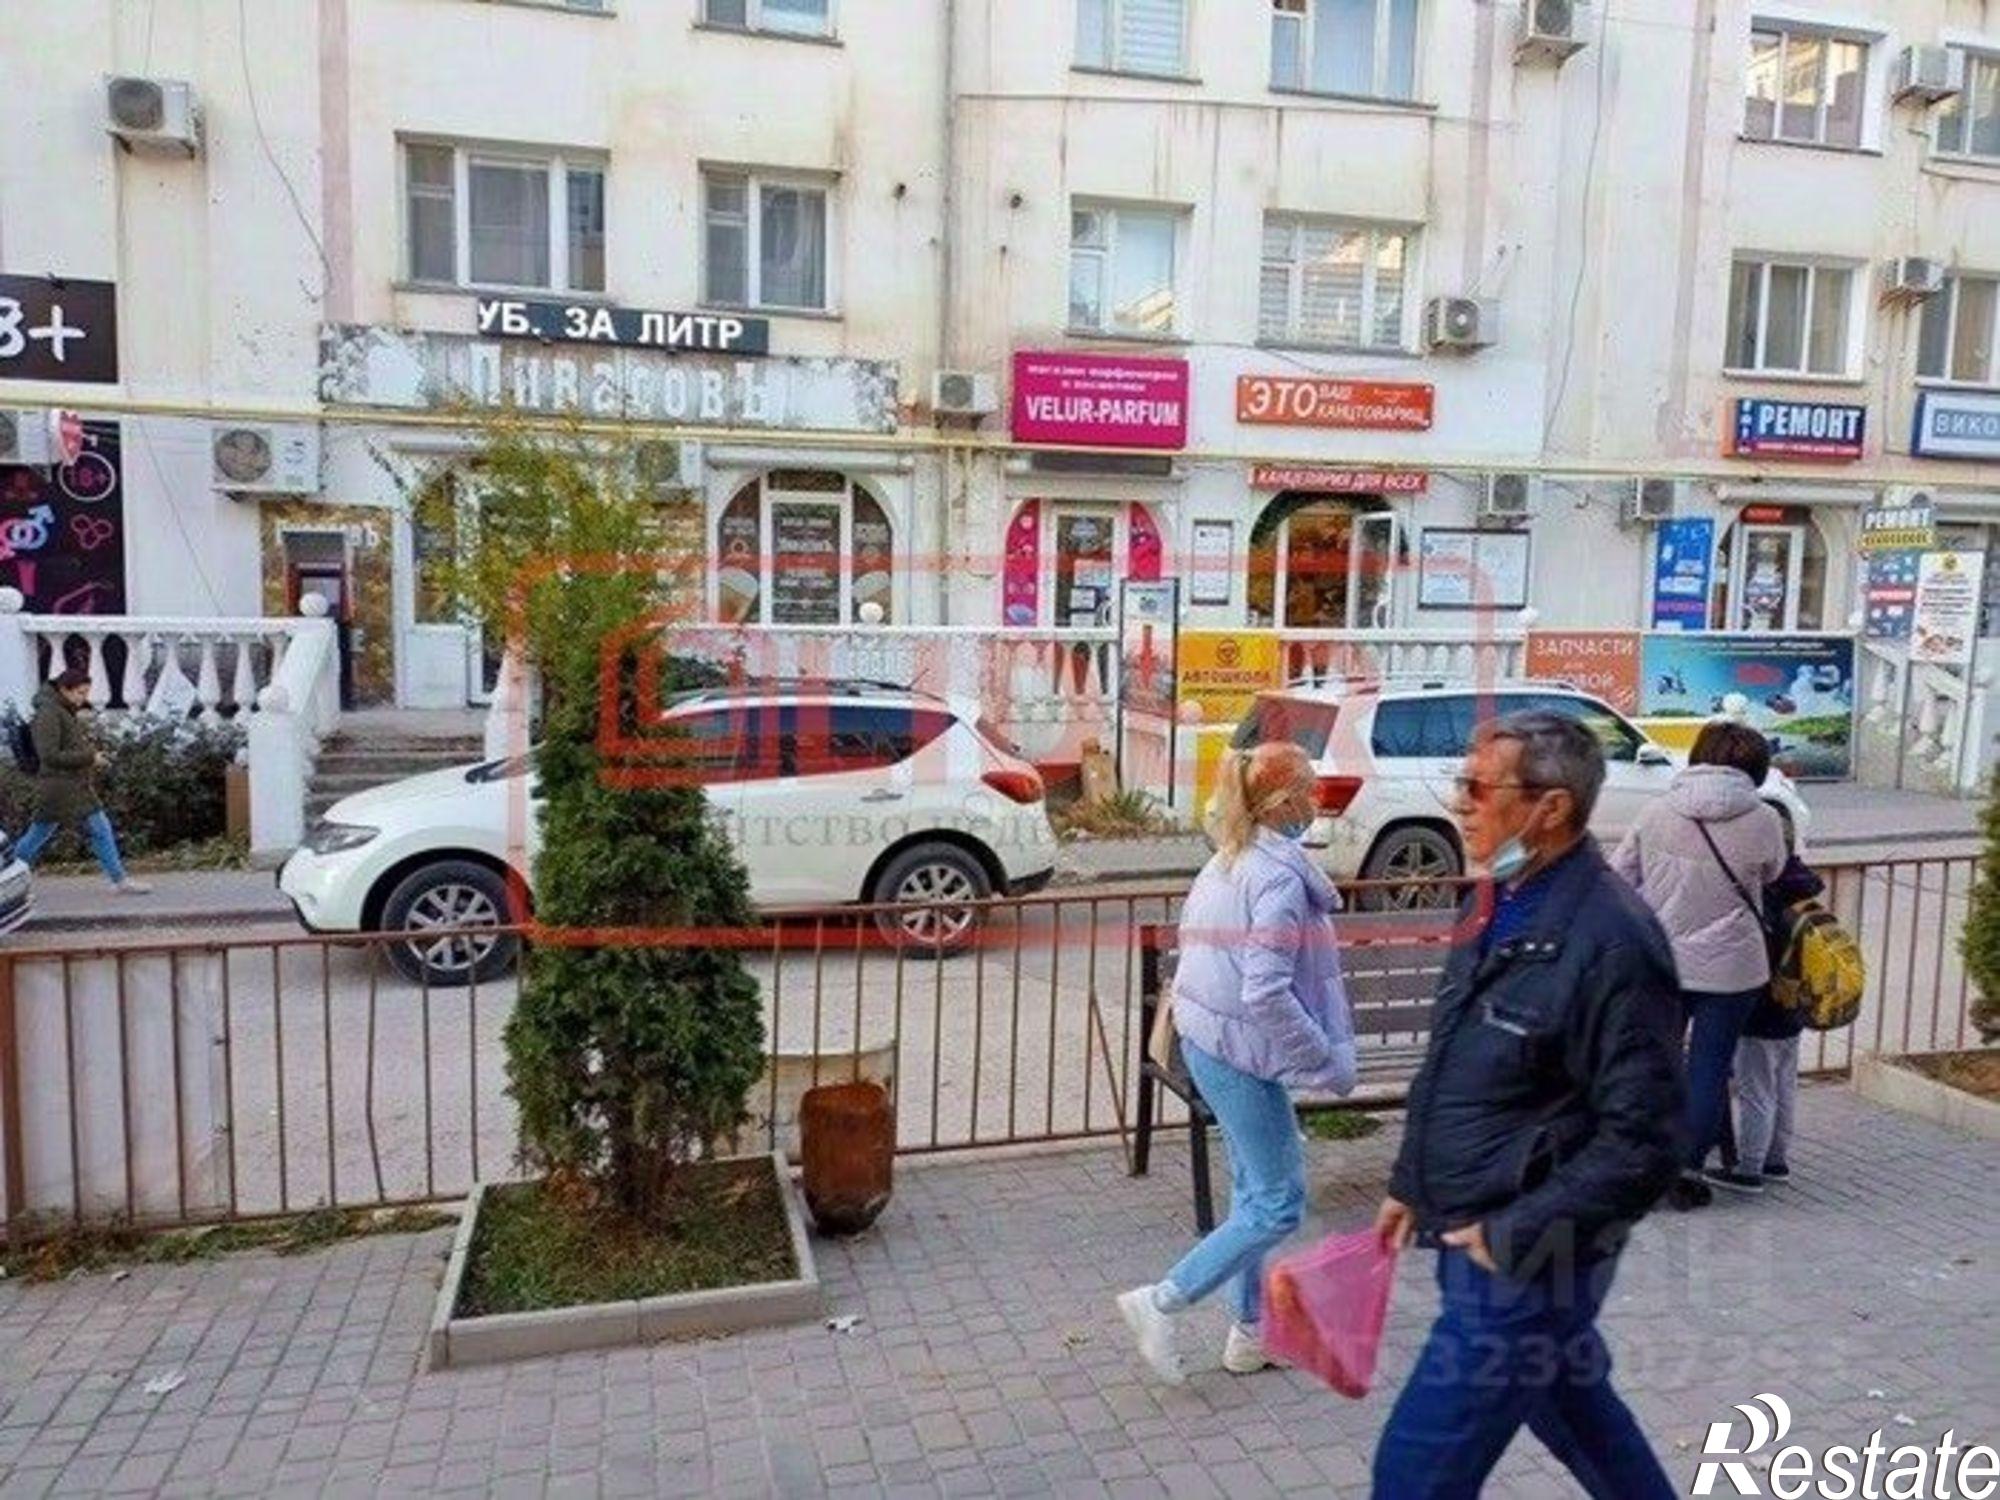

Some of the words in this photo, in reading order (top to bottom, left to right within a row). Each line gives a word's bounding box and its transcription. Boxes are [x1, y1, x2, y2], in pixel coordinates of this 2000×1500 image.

[478, 301, 541, 336] УБ.
[565, 307, 618, 341] ЗА
[638, 313, 743, 349] ЛИТР
[1025, 395, 1180, 427] VELUR-PARFUM
[1250, 380, 1318, 418] ЭТО
[1758, 403, 1862, 440] РЕМОНТ
[1536, 638, 1634, 657] ЗАПЧАСТИ
[1183, 669, 1271, 684] АВТОШКОЛА
